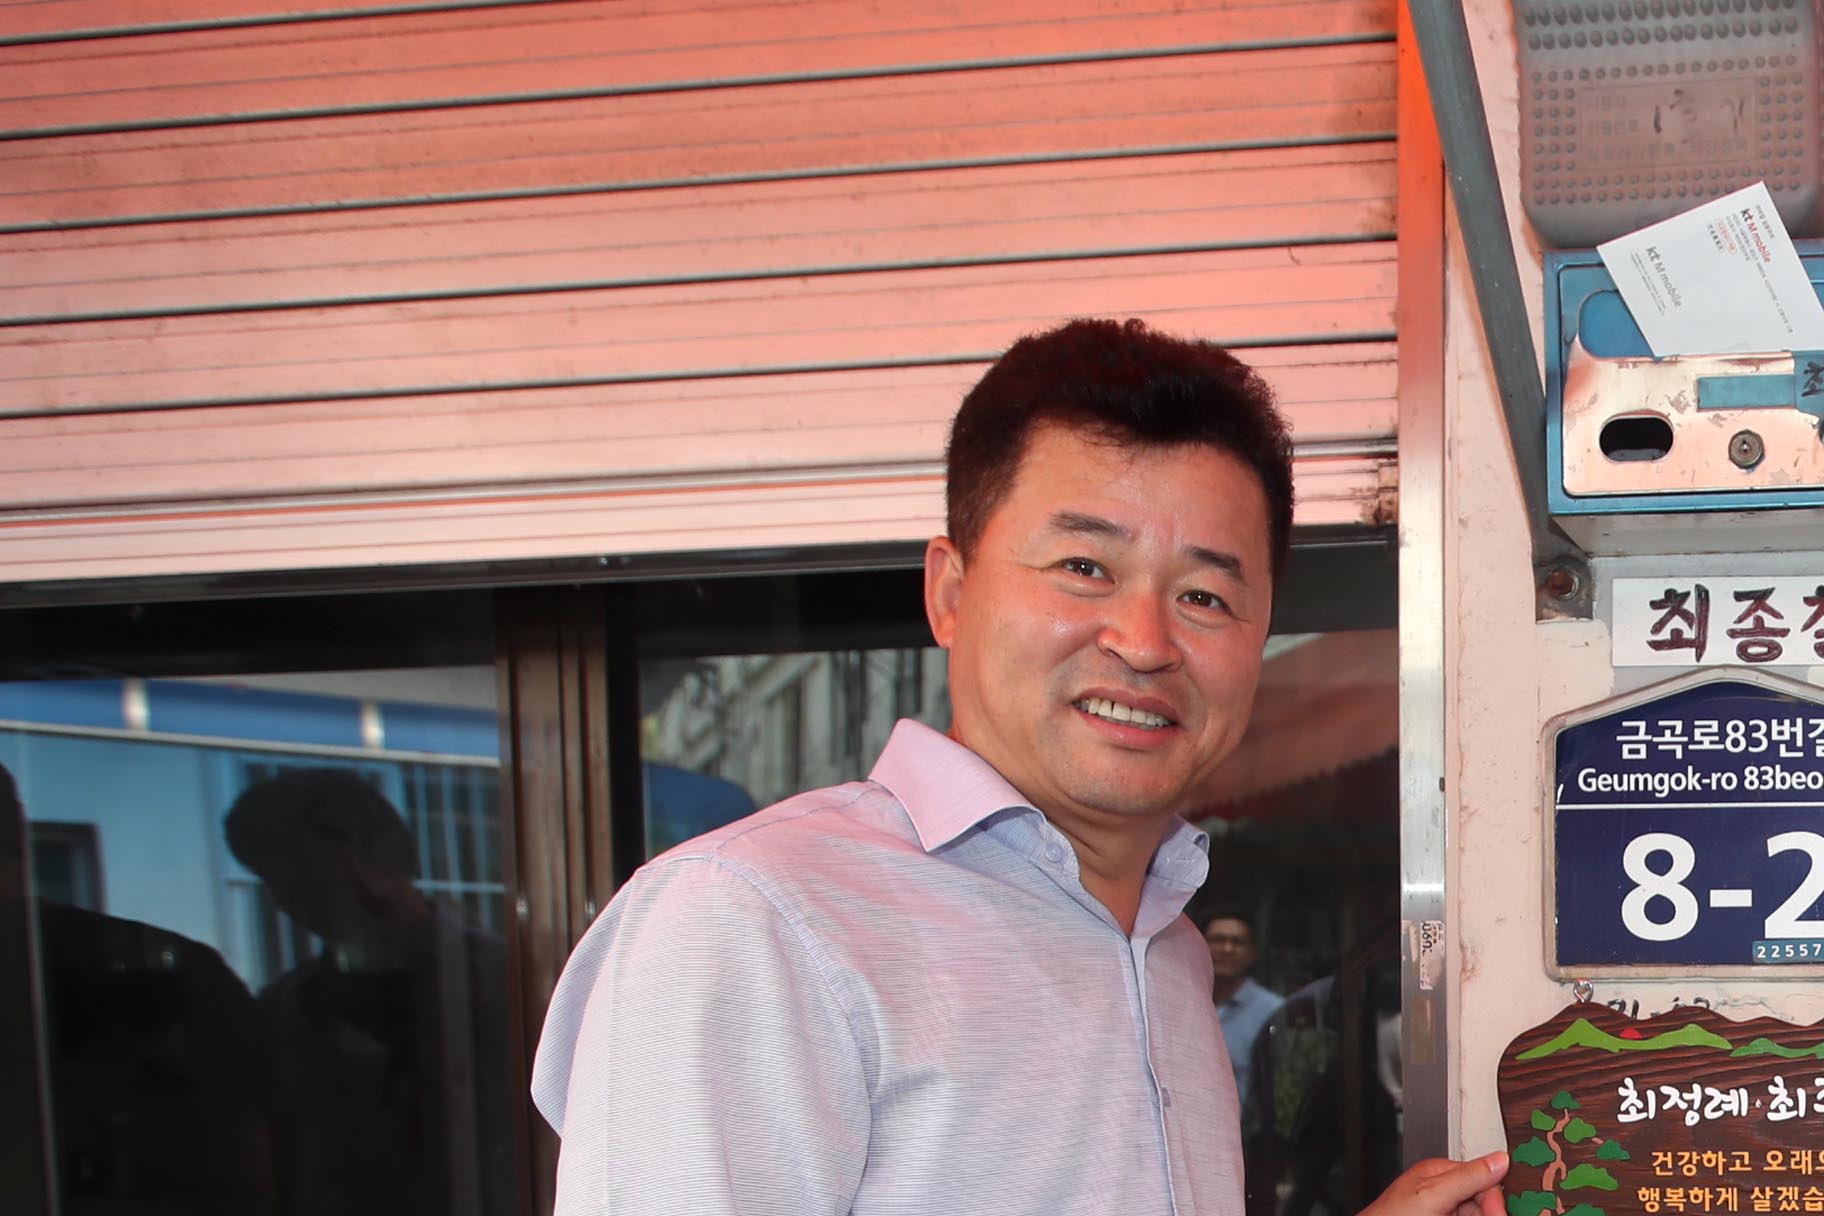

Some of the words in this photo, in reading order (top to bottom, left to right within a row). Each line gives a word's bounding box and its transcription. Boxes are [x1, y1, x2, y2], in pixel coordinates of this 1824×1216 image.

[1751, 230, 1771, 263] mobile
[1661, 271, 1682, 307] mobile
[1577, 767, 1738, 798] Geumgok-ro
[1756, 943, 1823, 959] 22557
[1650, 1151, 1752, 1178] 건강하고
[1637, 1186, 1740, 1214] 행복하게
